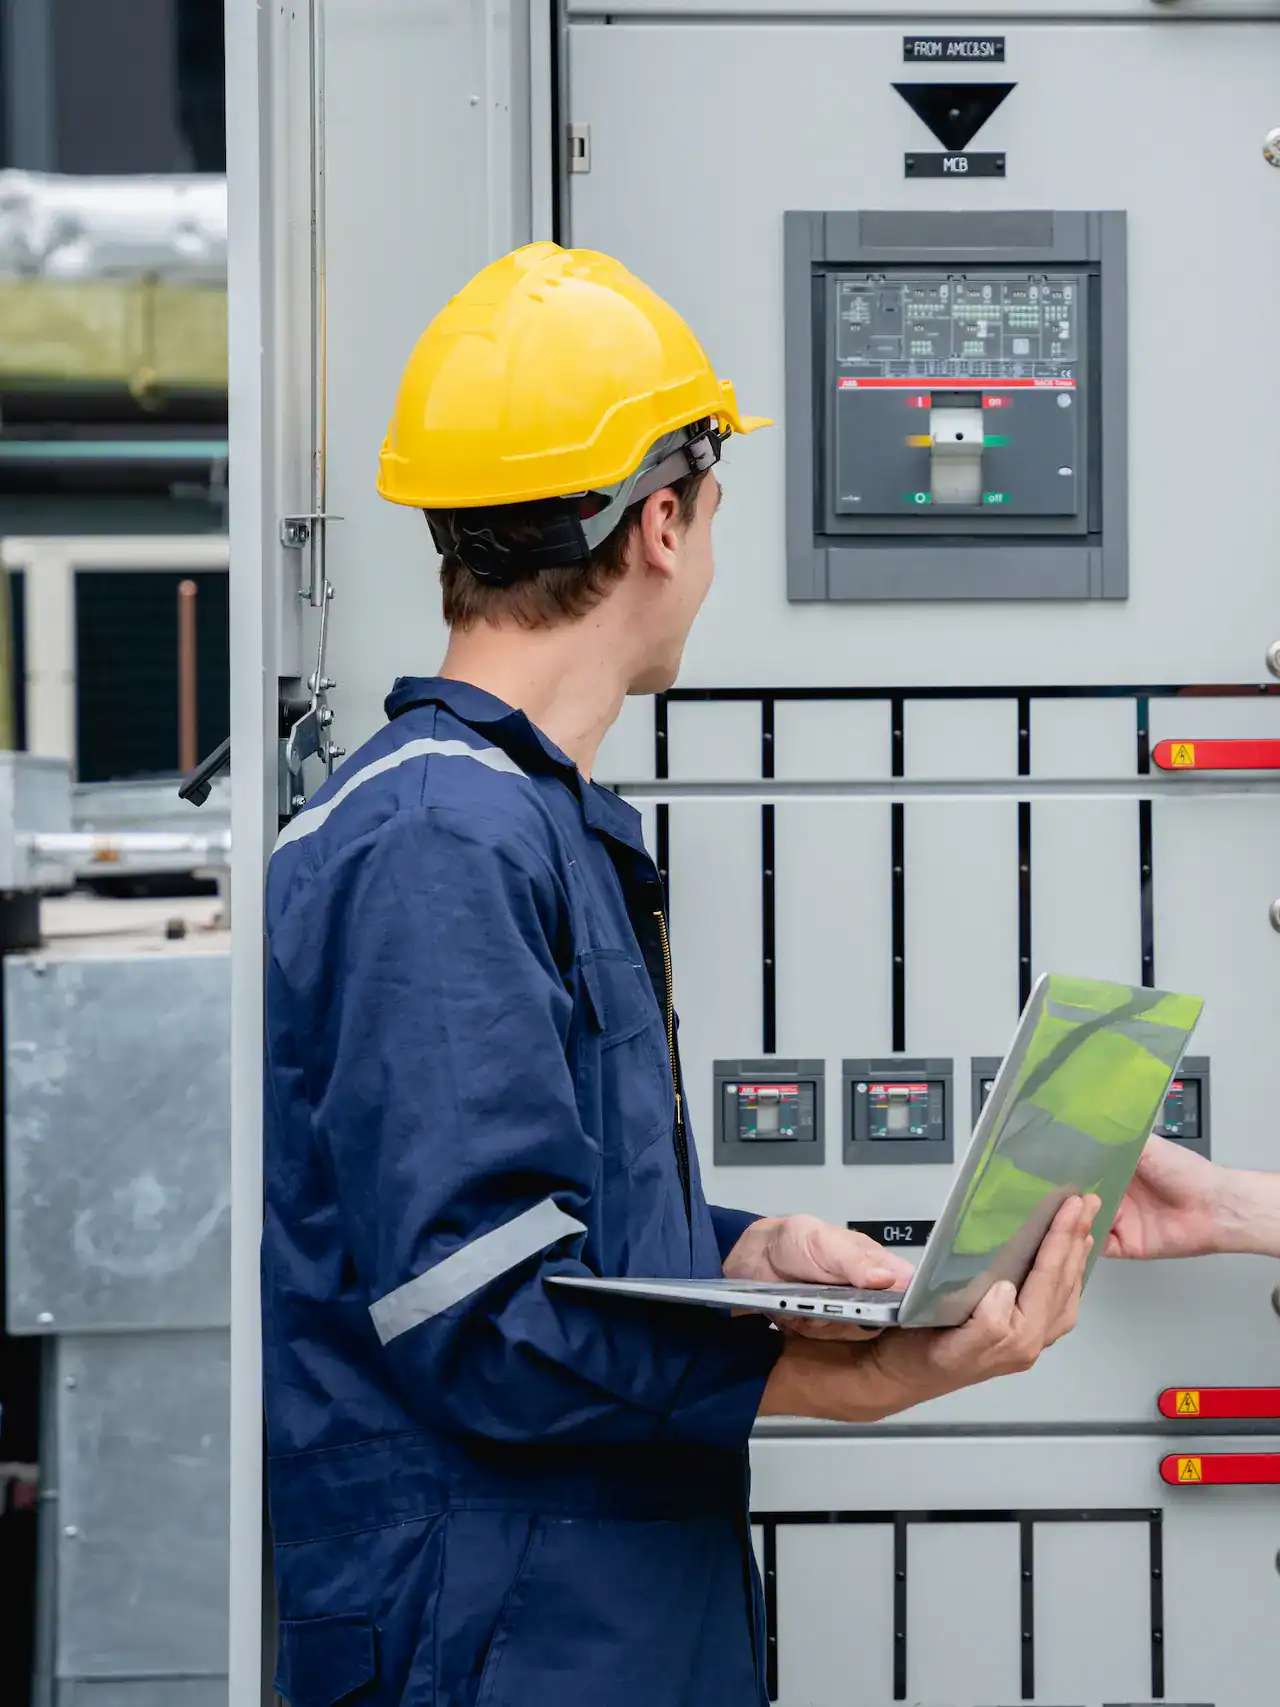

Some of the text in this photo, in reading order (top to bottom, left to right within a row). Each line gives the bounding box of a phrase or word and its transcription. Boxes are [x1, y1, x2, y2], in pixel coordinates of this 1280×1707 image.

[913, 41, 995, 56] FROM AMCC&SN
[943, 157, 969, 172] MCB
[988, 398, 1002, 406] on
[988, 493, 1003, 503] off
[883, 1226, 913, 1241] CH-2
